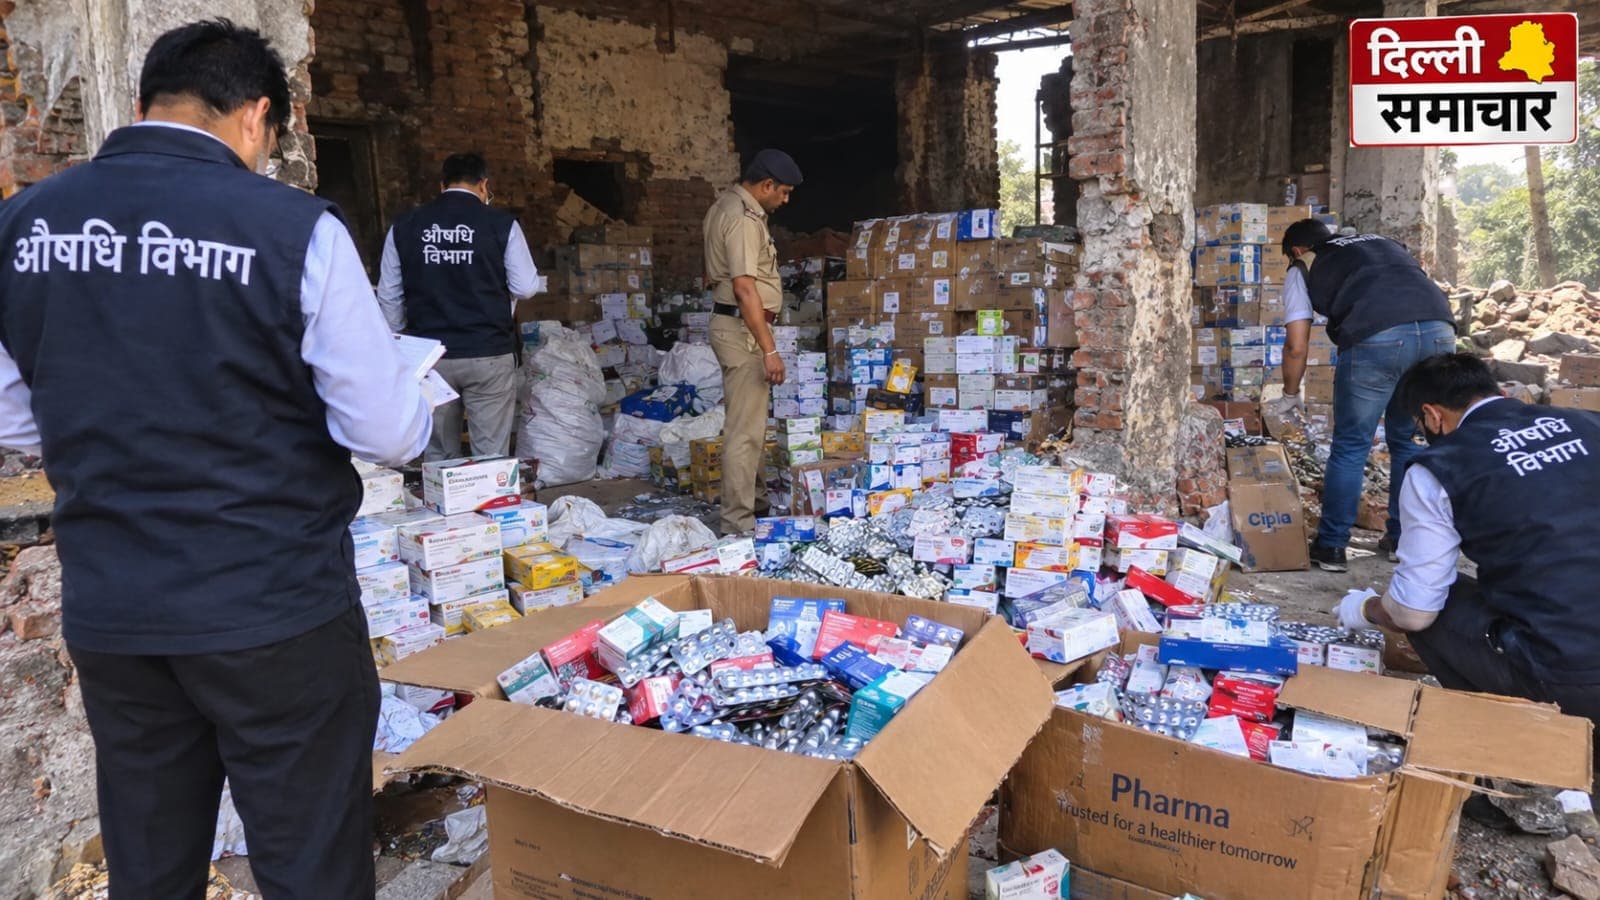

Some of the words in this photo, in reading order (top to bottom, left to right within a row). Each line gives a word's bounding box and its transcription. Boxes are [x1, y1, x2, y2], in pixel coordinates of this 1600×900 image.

[13, 218, 127, 273] औषधि
[138, 220, 256, 285] विभाग
[421, 223, 475, 243] औषधि
[422, 244, 474, 265] विभाग
[1490, 416, 1572, 453] औषधि
[1506, 438, 1589, 477] विभाग
[1248, 511, 1292, 529] Cipla
[1111, 772, 1230, 829] Pharma
[1057, 797, 1109, 825] Trusted
[1113, 812, 1133, 832] for
[1137, 821, 1146, 835] a
[1150, 821, 1216, 852] healthier
[1220, 840, 1298, 871] tomorrow
